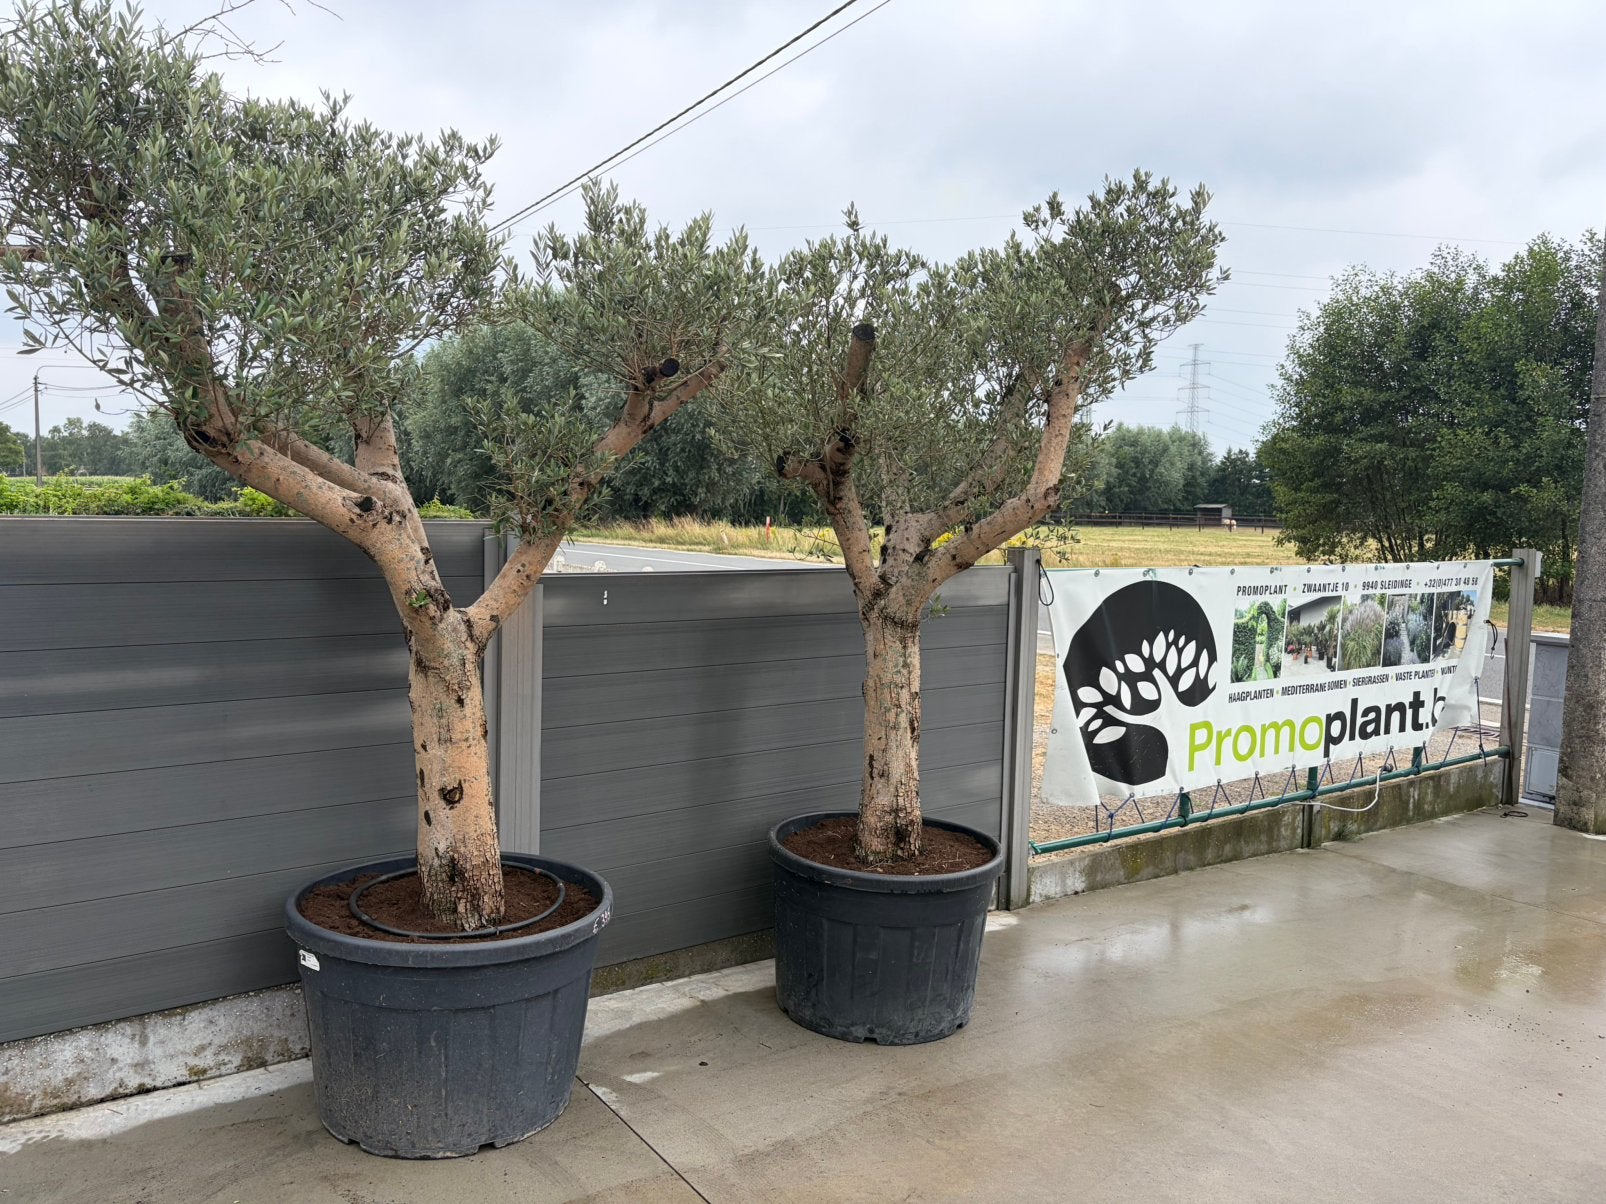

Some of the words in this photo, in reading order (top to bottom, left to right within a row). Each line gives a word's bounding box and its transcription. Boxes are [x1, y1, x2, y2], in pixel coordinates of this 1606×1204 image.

[1236, 584, 1288, 596] PROMOPLANT
[1302, 582, 1339, 594] ZWAANTJE
[1341, 582, 1350, 592] 10
[1362, 580, 1378, 591] 9940
[1380, 579, 1412, 590] SLEIDINGE
[1228, 688, 1275, 703] HAAGPLANTEN
[1281, 682, 1326, 696] MEDITERRANE
[1352, 673, 1390, 687] SIERGRASSEN
[1395, 671, 1413, 682] VASTE
